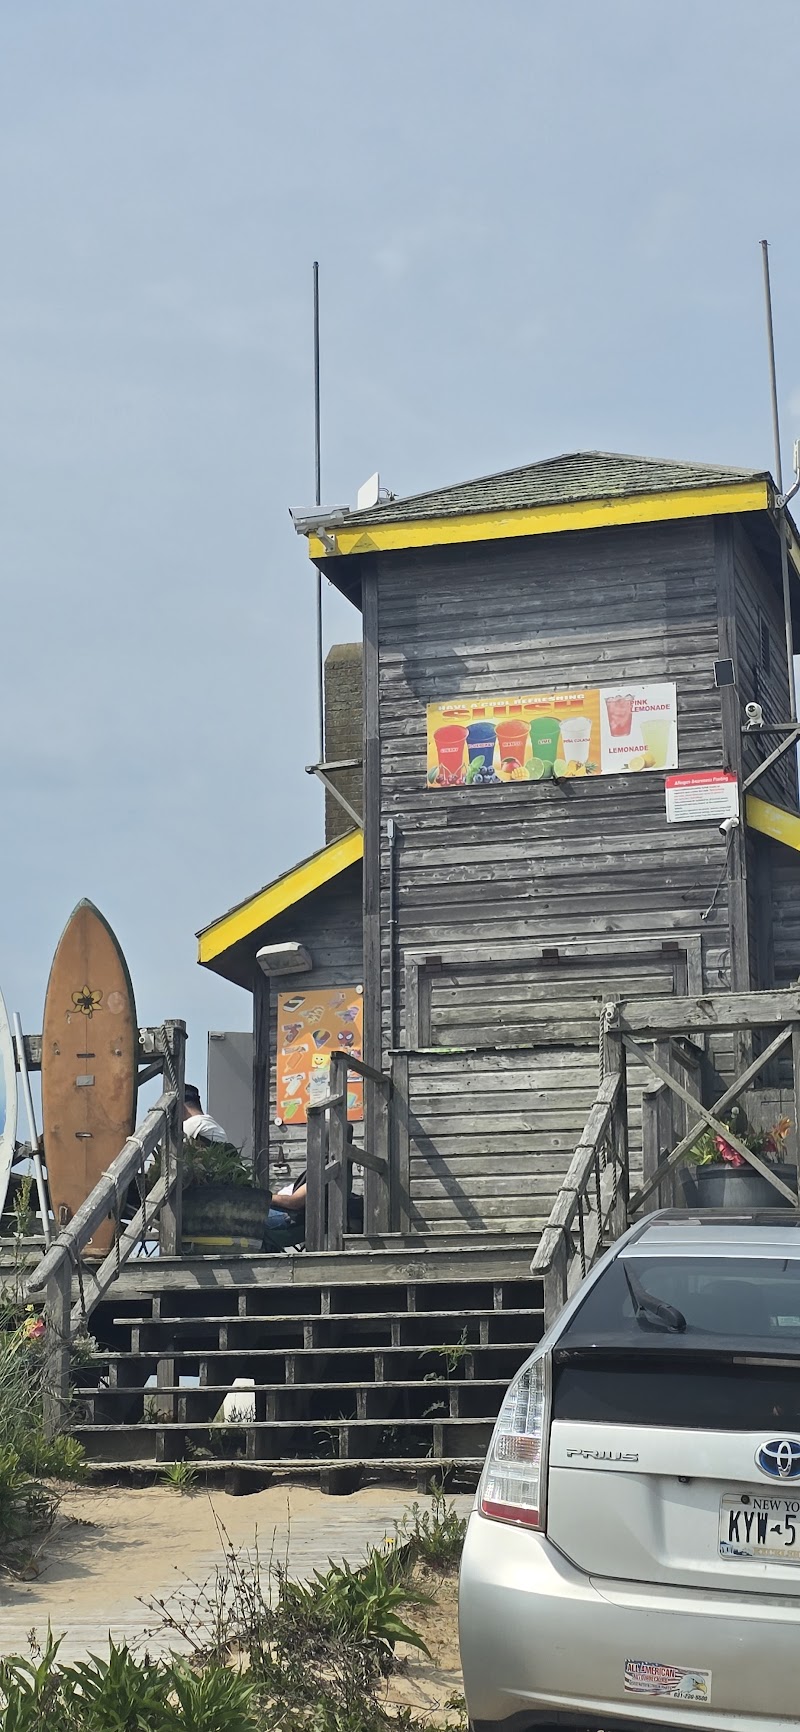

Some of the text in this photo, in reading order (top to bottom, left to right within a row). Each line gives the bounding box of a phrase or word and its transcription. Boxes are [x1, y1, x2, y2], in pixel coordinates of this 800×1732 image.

[481, 700, 510, 708] COOL
[513, 694, 585, 706] REFRESHING
[442, 699, 584, 722] SLUSH
[630, 704, 671, 712] LEMONADE
[608, 745, 649, 753] LEMONADE
[566, 1448, 639, 1462] PRIUS
[753, 1499, 781, 1511] NEW
